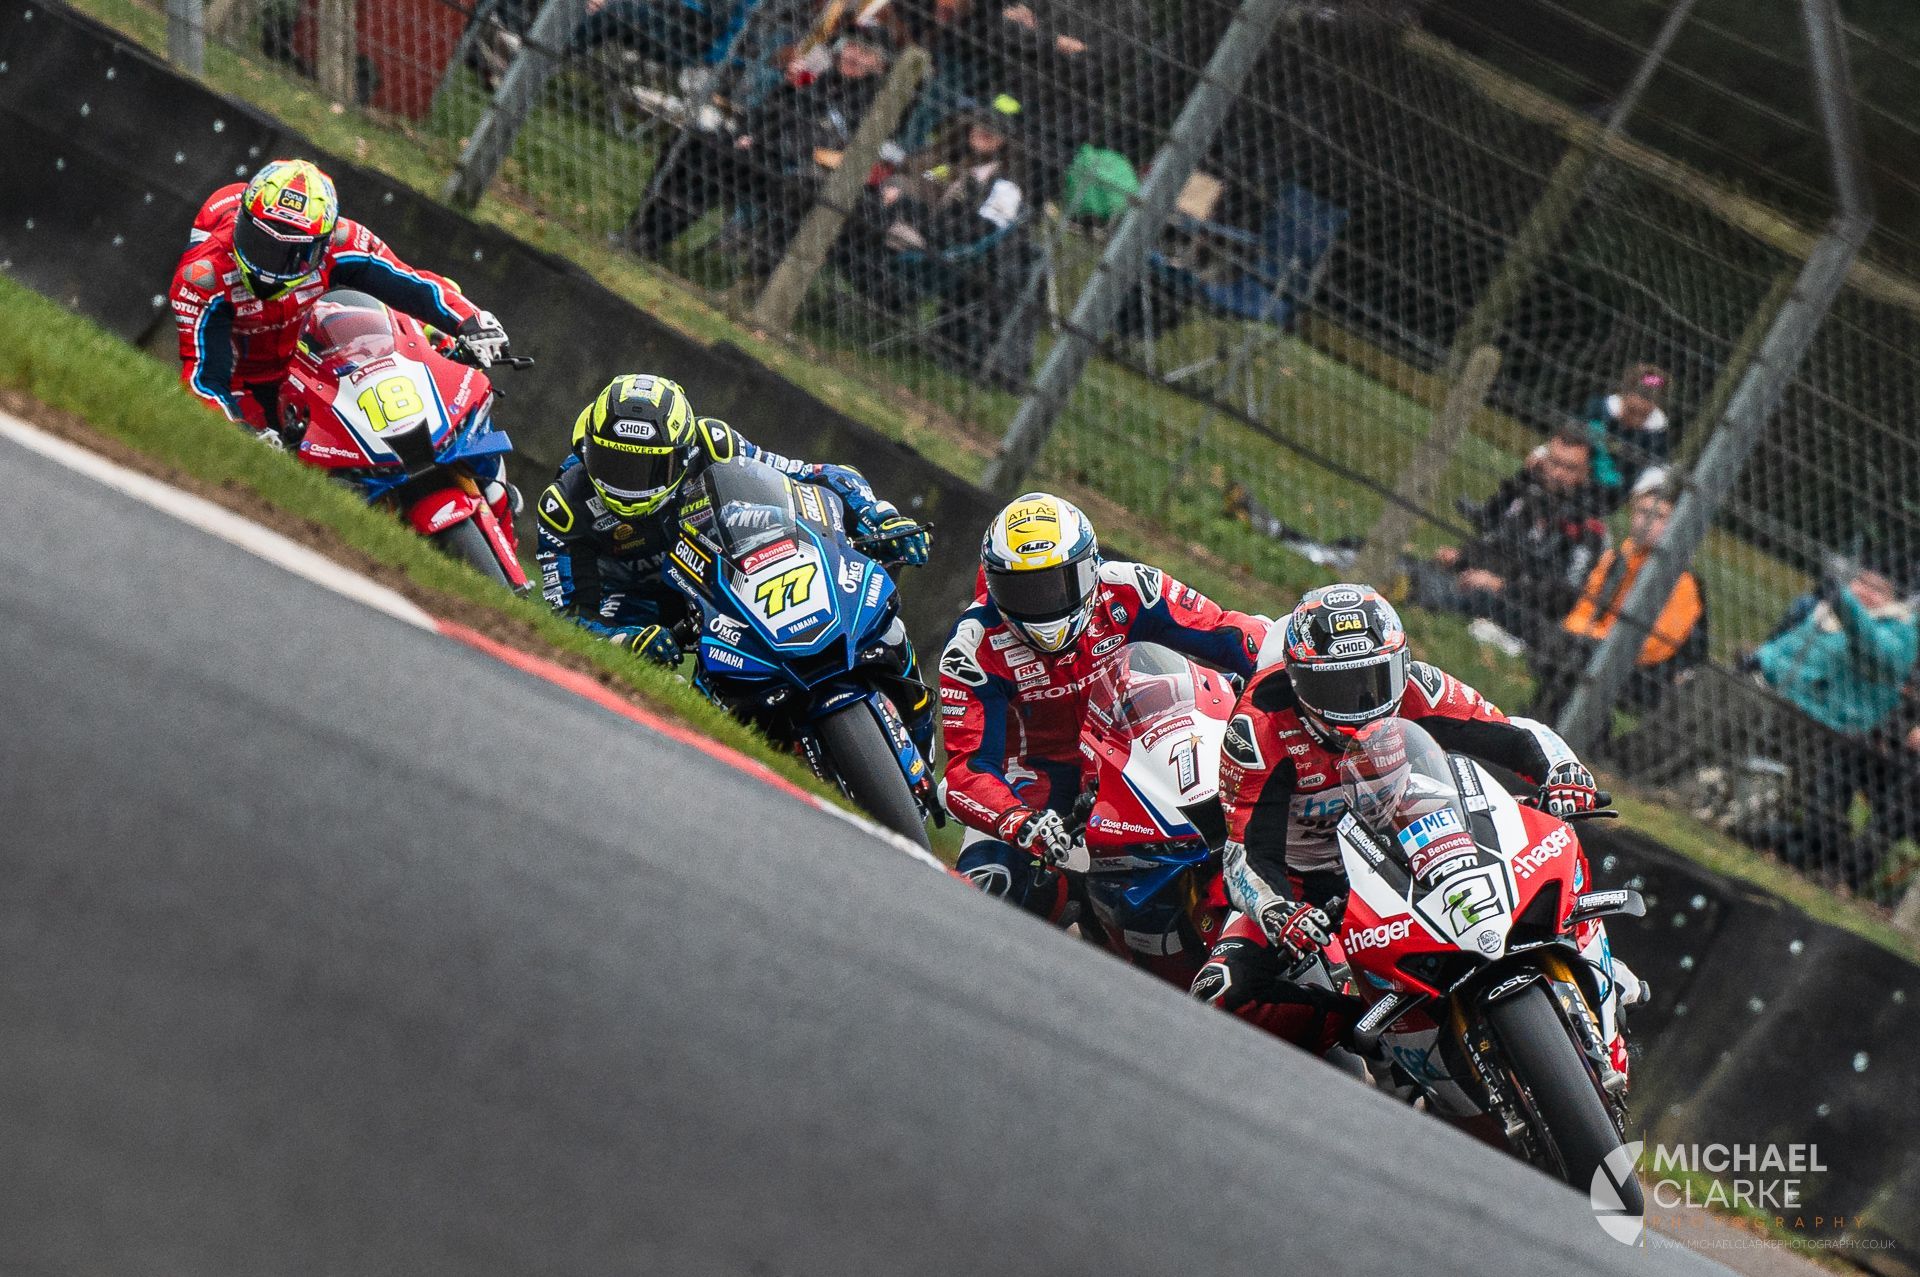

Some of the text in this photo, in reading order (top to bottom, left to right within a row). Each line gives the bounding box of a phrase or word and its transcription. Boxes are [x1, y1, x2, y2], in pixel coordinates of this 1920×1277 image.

[281, 198, 303, 210] CAB
[357, 375, 424, 433] 18
[619, 423, 650, 436] SHOEI
[1008, 507, 1056, 523] ATLAS
[758, 542, 794, 561] Bennetts
[754, 562, 818, 619] 77
[865, 573, 884, 608] YAMAHA
[787, 615, 818, 634] YAMAHA
[1335, 613, 1359, 622] fona
[1335, 620, 1362, 632] CAB
[1335, 640, 1368, 655] SHOEI
[708, 646, 744, 670] YAMAHA
[1020, 663, 1040, 676] RK
[1157, 719, 1193, 736] Bennetts
[1168, 738, 1201, 795] 1
[1374, 747, 1406, 768] IRWIN
[1219, 766, 1244, 783] evlar
[1101, 818, 1155, 836] Close Brothers
[1422, 809, 1456, 833] MET
[1350, 825, 1386, 863] Silkolene
[1427, 836, 1472, 857] Bennetts
[1514, 826, 1572, 879] :hager
[1442, 873, 1505, 938] 2
[1344, 917, 1414, 955] :hager
